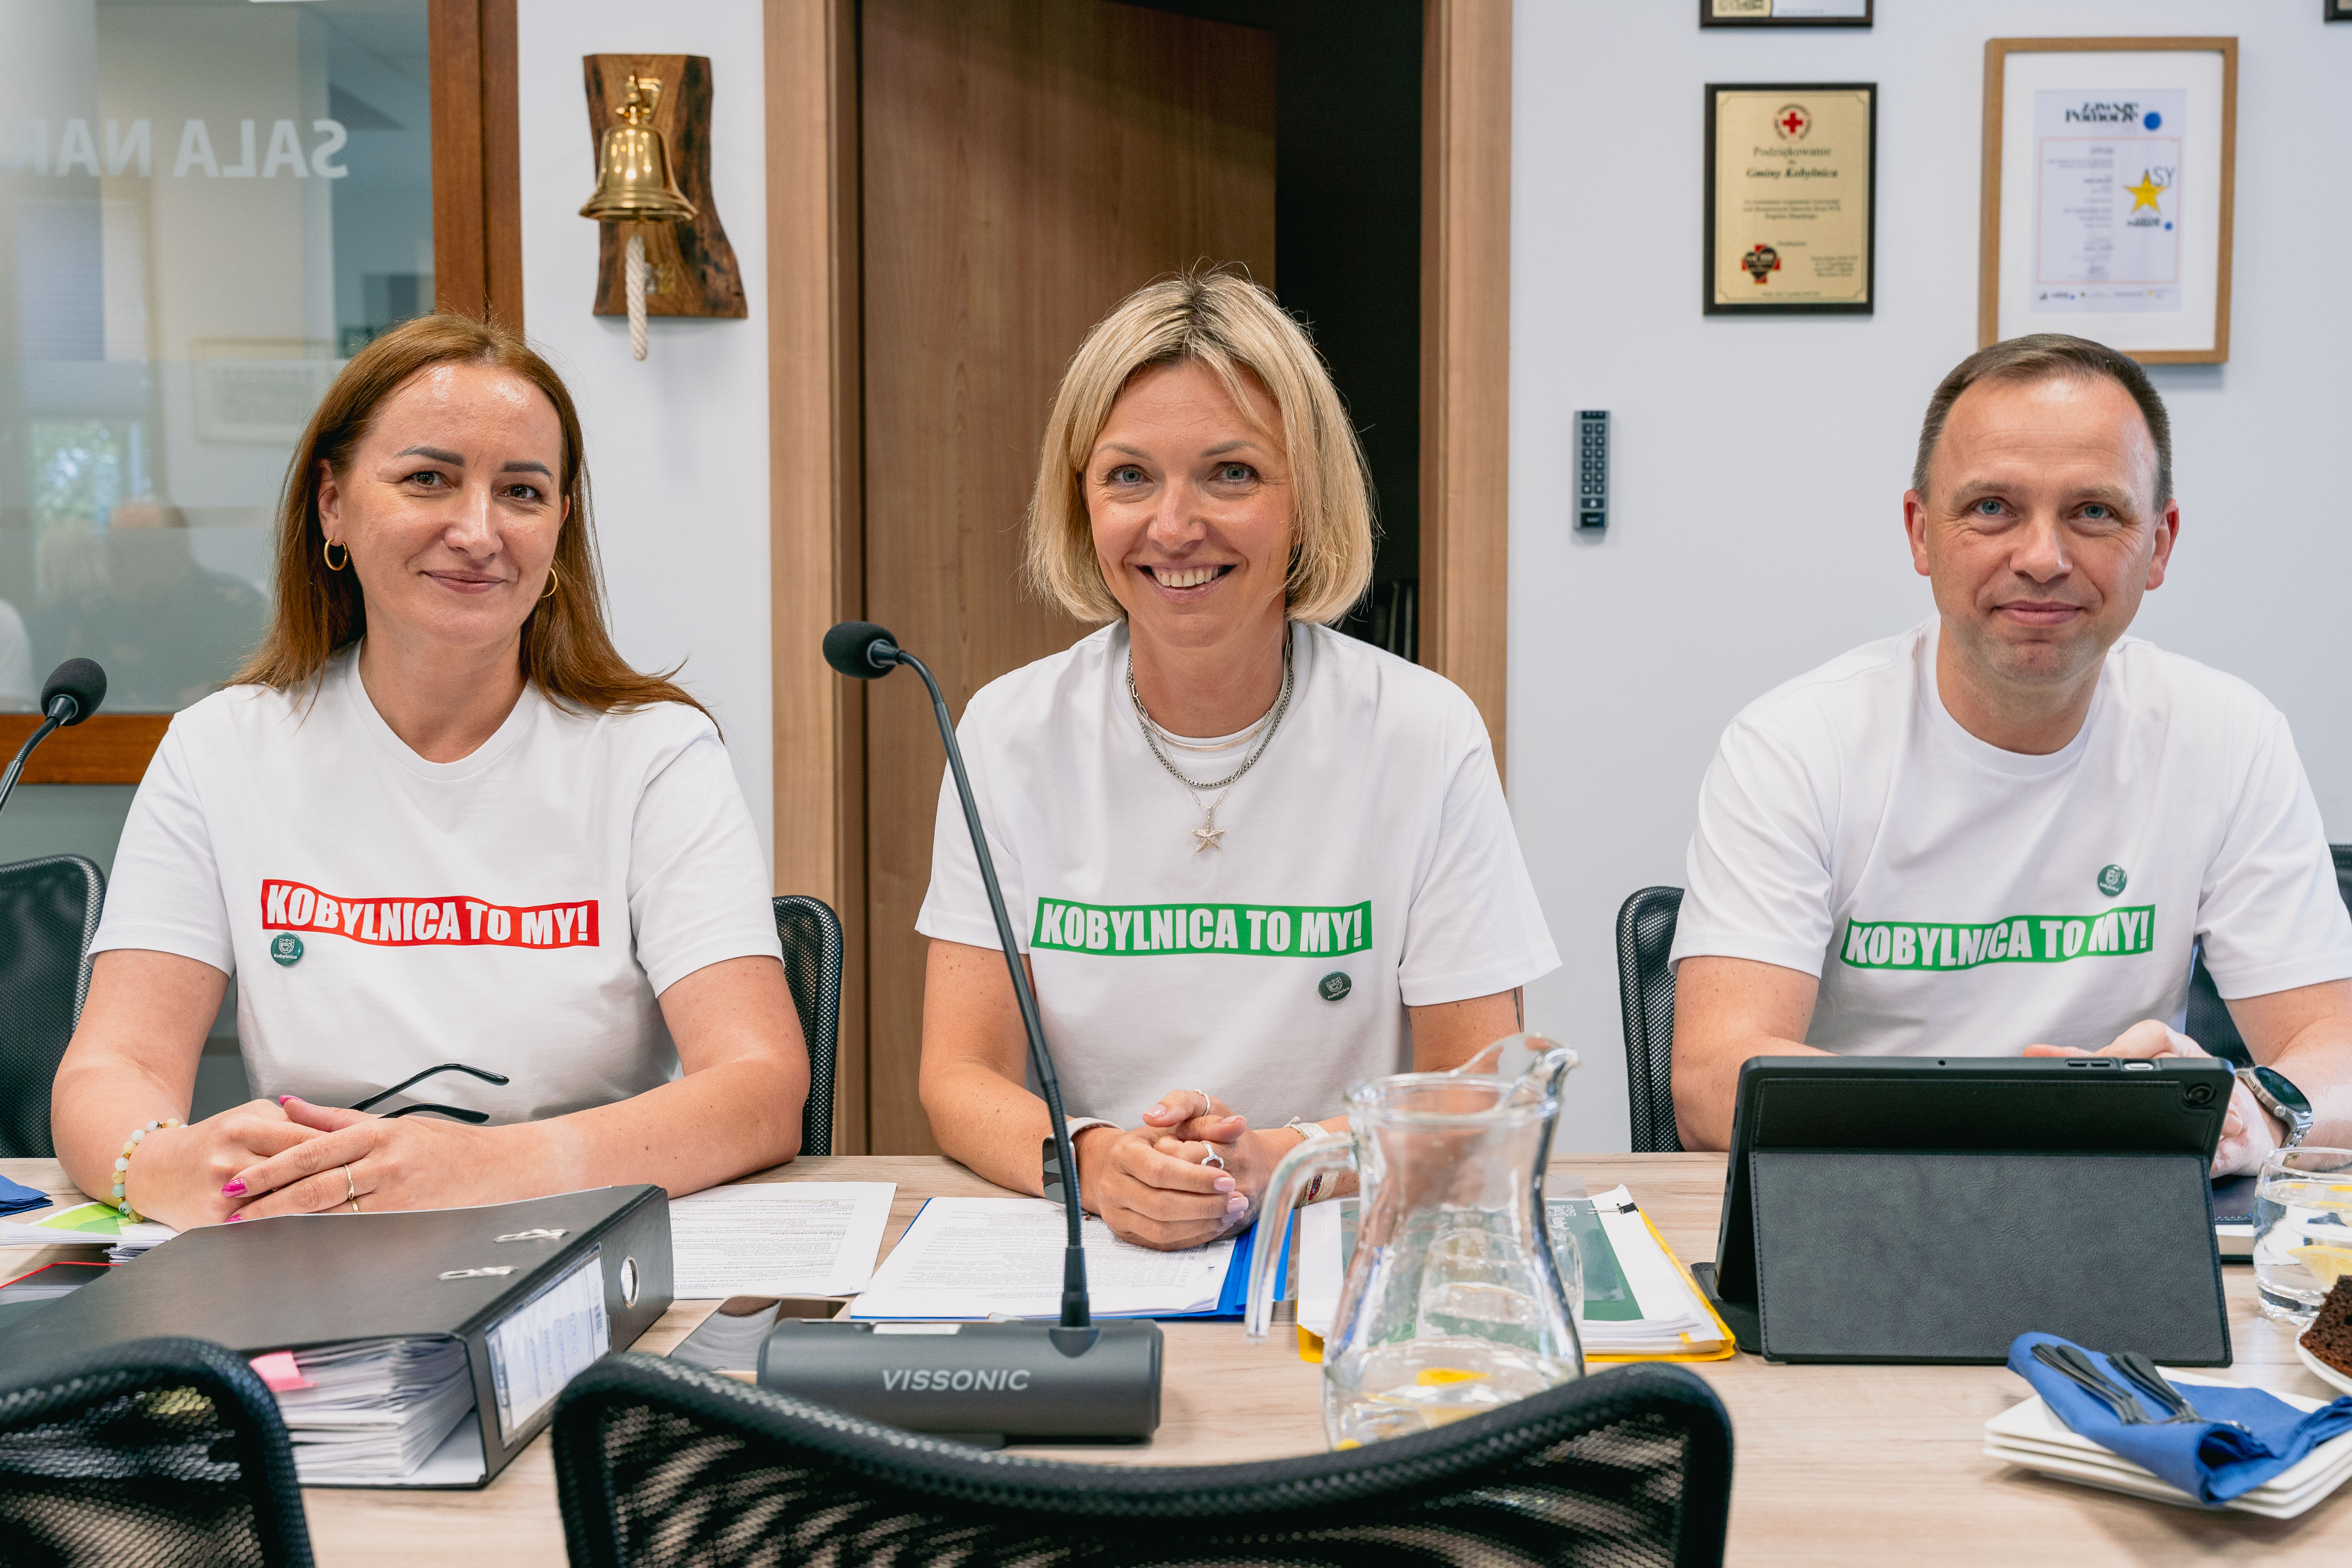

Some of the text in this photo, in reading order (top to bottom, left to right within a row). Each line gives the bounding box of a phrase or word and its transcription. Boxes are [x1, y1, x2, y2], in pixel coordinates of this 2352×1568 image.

[267, 885, 589, 945] KOBYLNICA TO MY!
[1040, 903, 1362, 953] KOBYLNICA TO MY!
[1845, 910, 2150, 967] KOBYLNICA TO MY!
[1327, 987, 1350, 999] Kobylnica
[882, 1369, 1031, 1391] VISSONIC
